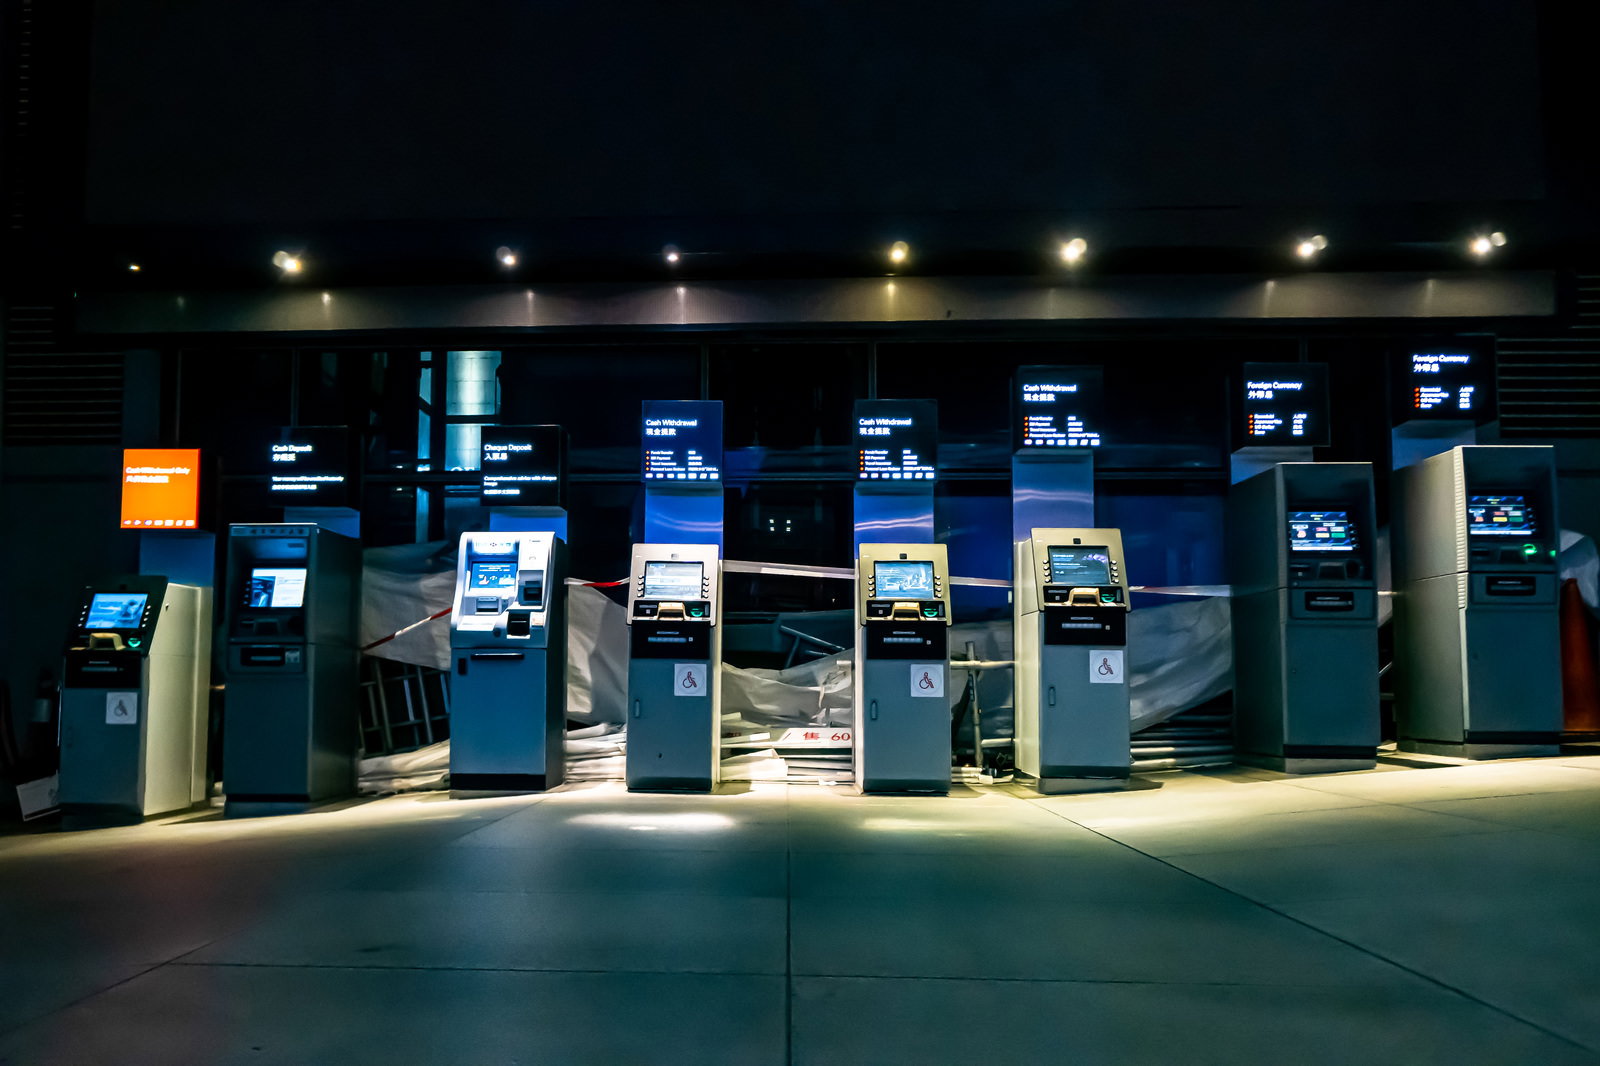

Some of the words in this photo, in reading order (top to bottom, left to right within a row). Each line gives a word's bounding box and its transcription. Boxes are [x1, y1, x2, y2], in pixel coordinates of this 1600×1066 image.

[1412, 354, 1438, 363] Foreign
[1023, 384, 1039, 392] Cash
[1040, 384, 1077, 392] Withdrawal
[1247, 381, 1272, 390] Foreign
[1273, 381, 1303, 390] Currency
[645, 419, 661, 427] Cash
[662, 419, 698, 427] Withdrawal
[859, 418, 875, 426] Cash
[876, 418, 912, 426] Withdrawal
[289, 444, 313, 453] Deposit
[484, 444, 508, 452] Cheque
[508, 443, 532, 452] Deposit
[831, 732, 851, 741] 60
